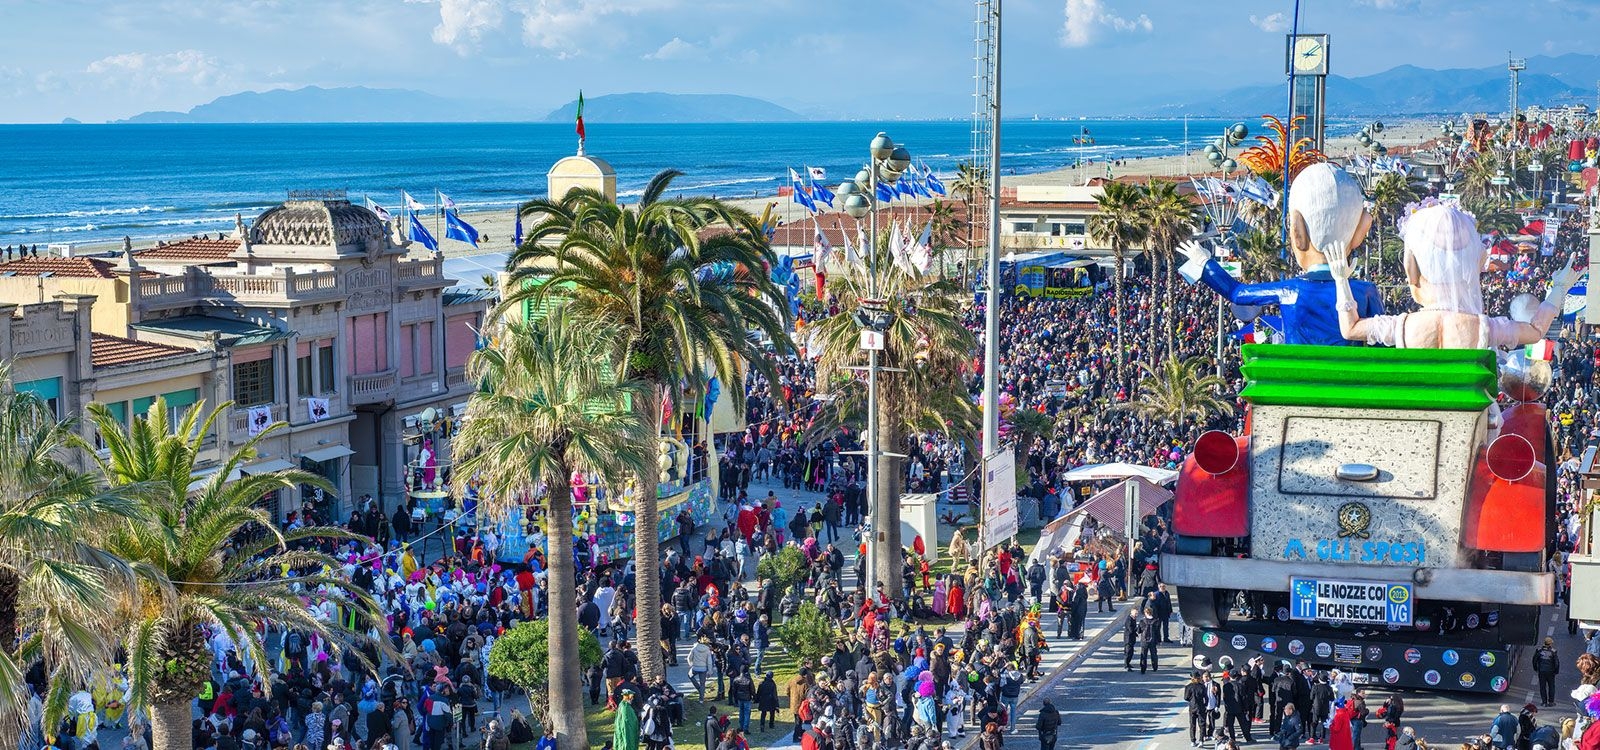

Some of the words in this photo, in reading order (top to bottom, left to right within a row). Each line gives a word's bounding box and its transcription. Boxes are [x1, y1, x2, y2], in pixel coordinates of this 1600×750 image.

[868, 333, 875, 347] 4
[1283, 537, 1307, 558] A
[1318, 583, 1330, 598] LE
[1331, 584, 1366, 600] NOZZE
[1368, 586, 1386, 601] COI
[1300, 598, 1312, 617] IT
[1317, 603, 1345, 618] FICHI
[1346, 604, 1386, 620] SECCHI
[1389, 603, 1408, 622] VG
